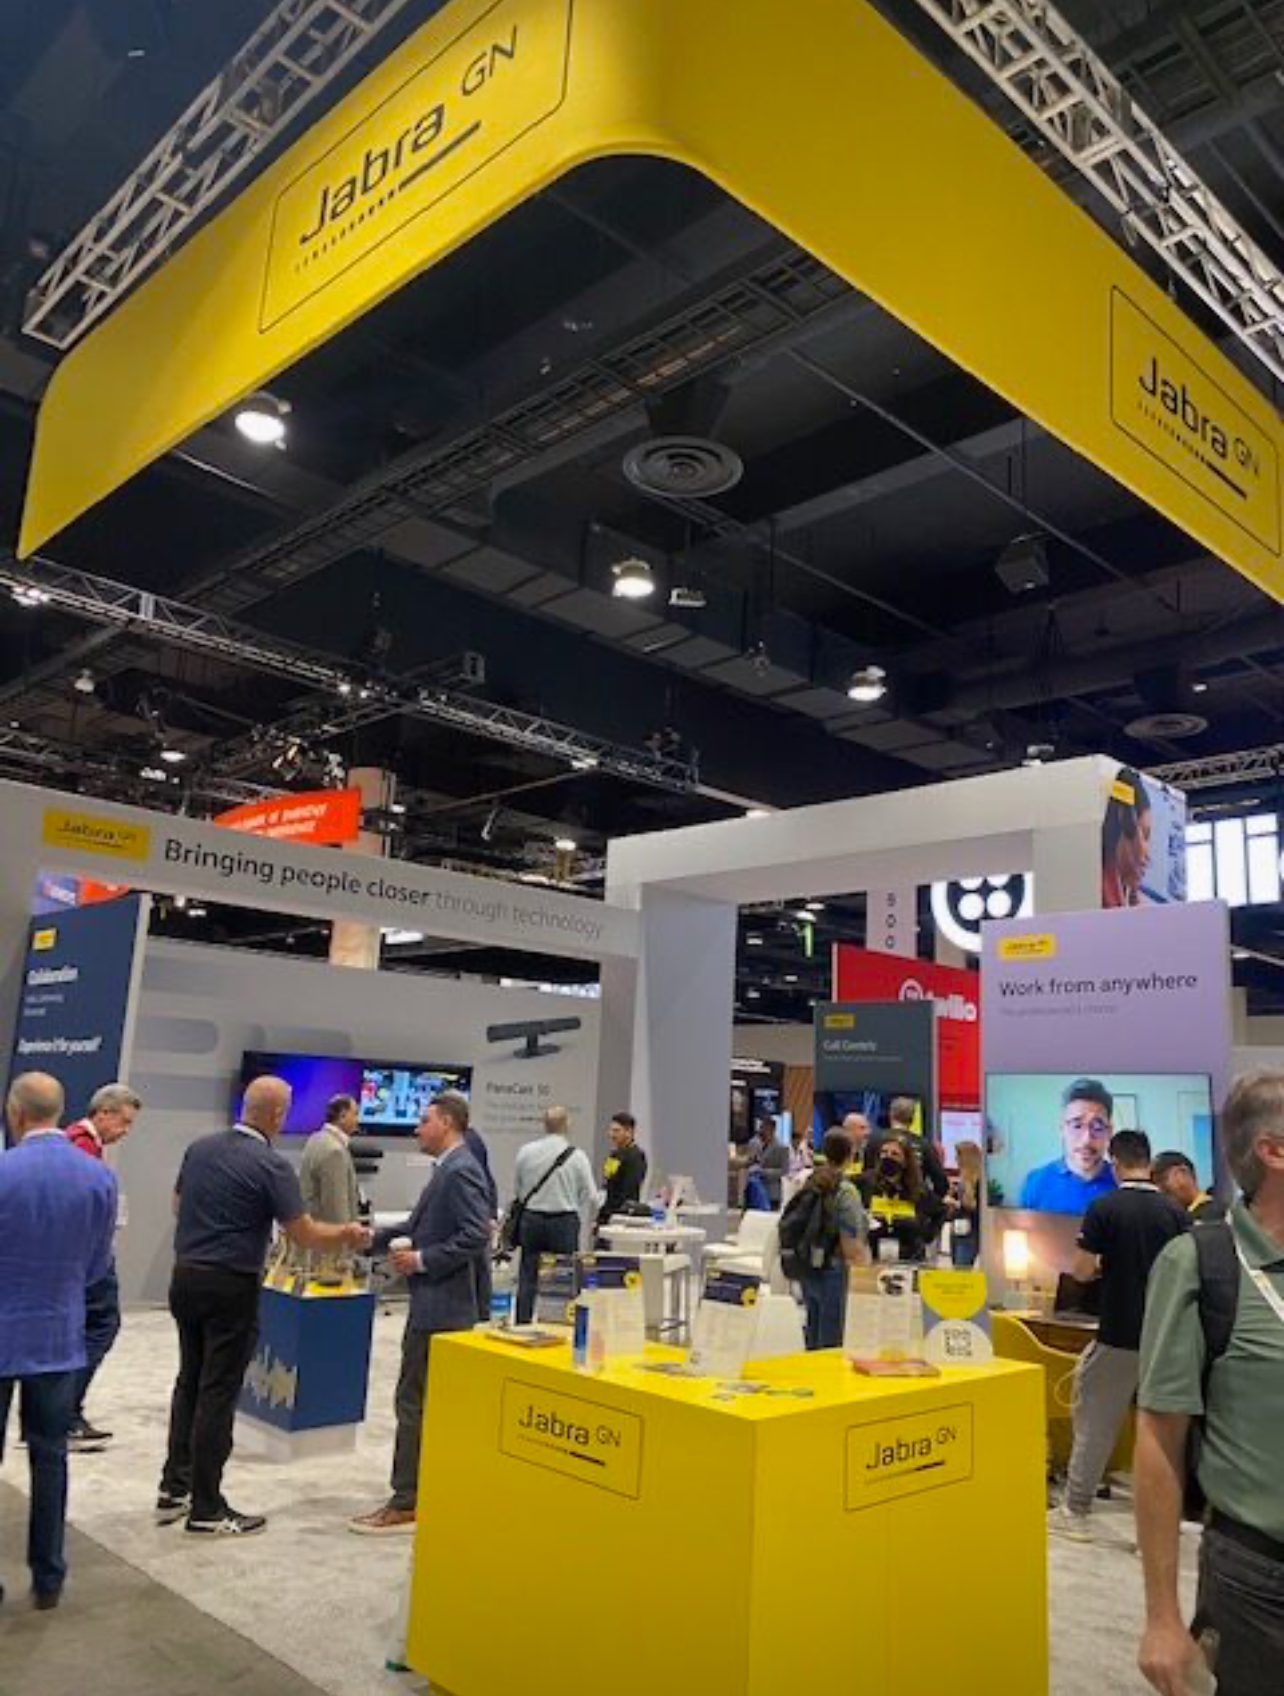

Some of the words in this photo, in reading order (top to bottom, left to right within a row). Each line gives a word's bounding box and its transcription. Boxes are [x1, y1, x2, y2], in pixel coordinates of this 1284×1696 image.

[299, 103, 445, 245] Jabra
[461, 24, 518, 97] GN
[1138, 355, 1229, 459] Jabra
[164, 838, 274, 883] Bringing
[280, 865, 361, 894] people
[366, 878, 429, 905] closer
[434, 890, 506, 923] through
[512, 905, 601, 940] technology
[1000, 979, 1044, 997] Work
[1050, 977, 1095, 994] from
[1100, 972, 1198, 995] anywhere
[518, 1405, 589, 1446] Jabra
[596, 1425, 621, 1447] GN
[866, 1437, 931, 1470] Jabra
[936, 1425, 958, 1444] GN
